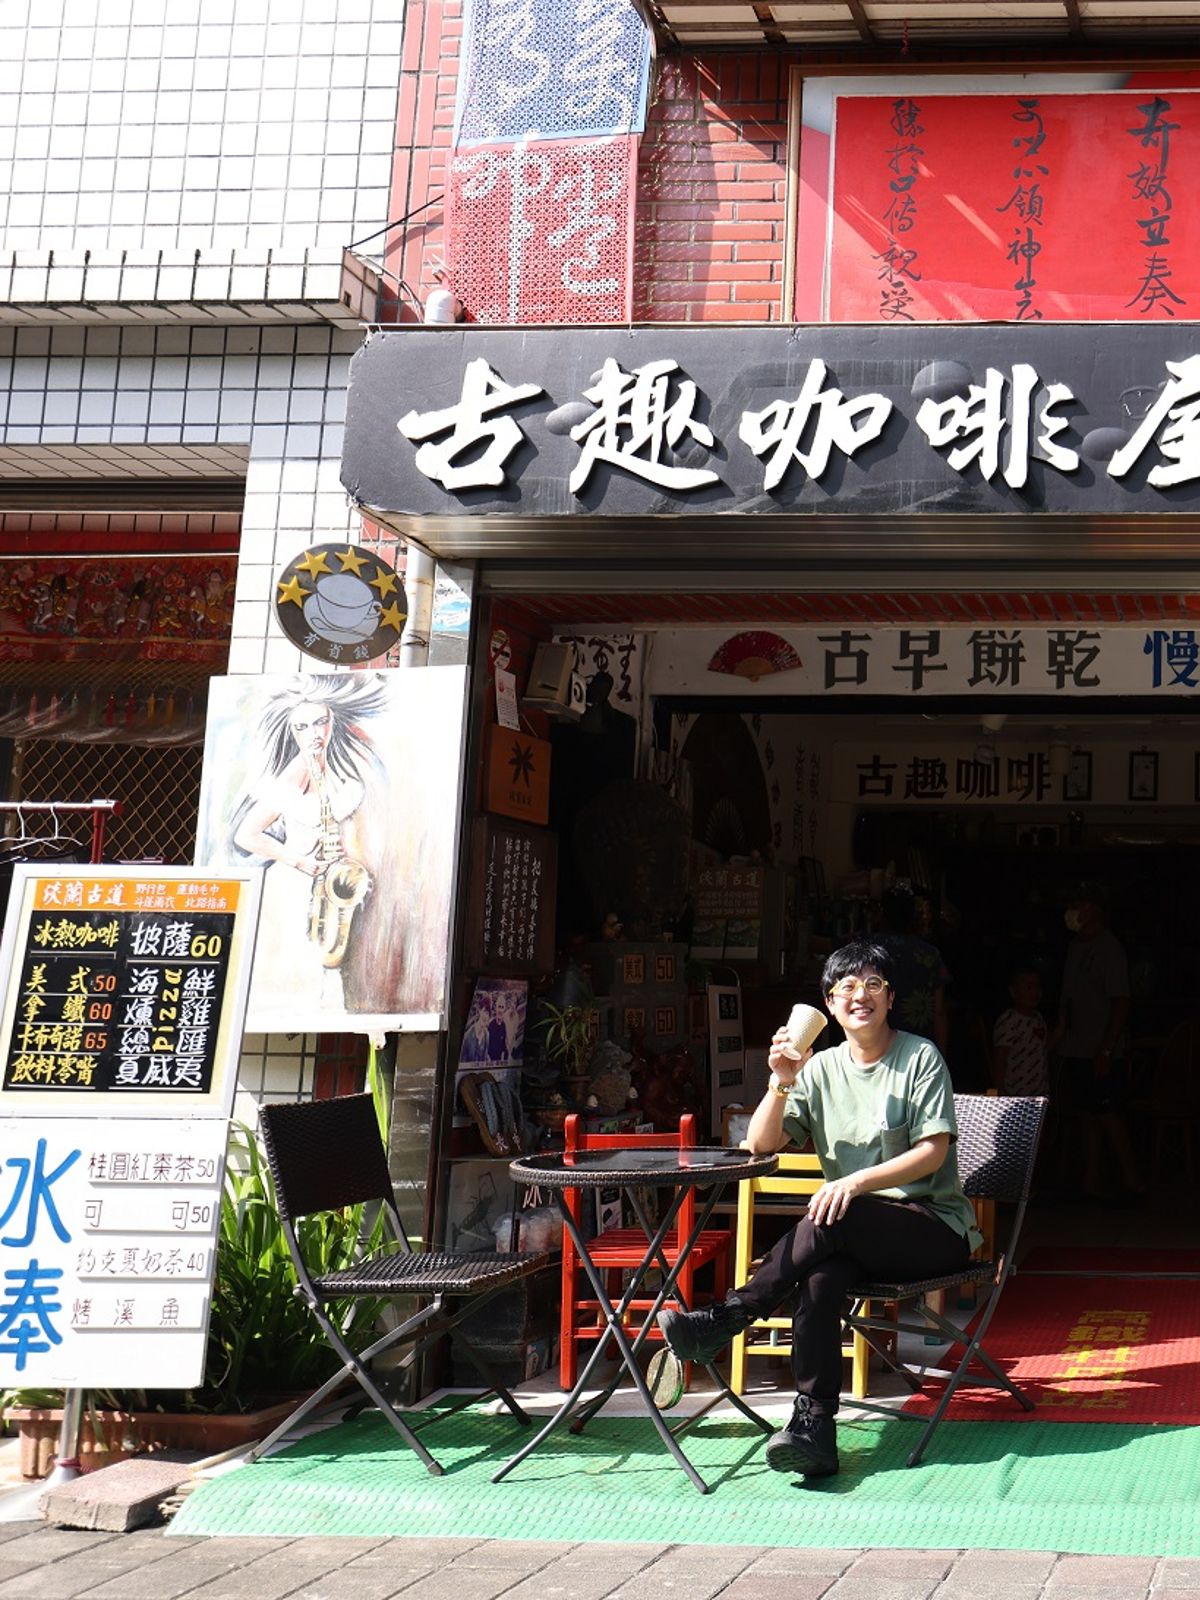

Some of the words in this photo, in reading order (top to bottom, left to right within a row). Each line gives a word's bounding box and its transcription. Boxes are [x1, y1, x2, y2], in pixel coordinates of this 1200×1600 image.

[818, 630, 1101, 690] 古早餅乾
[856, 753, 1052, 802] 古趣咖啡
[34, 918, 120, 948] 冰熱咖啡
[115, 1056, 205, 1087] 夏威夷
